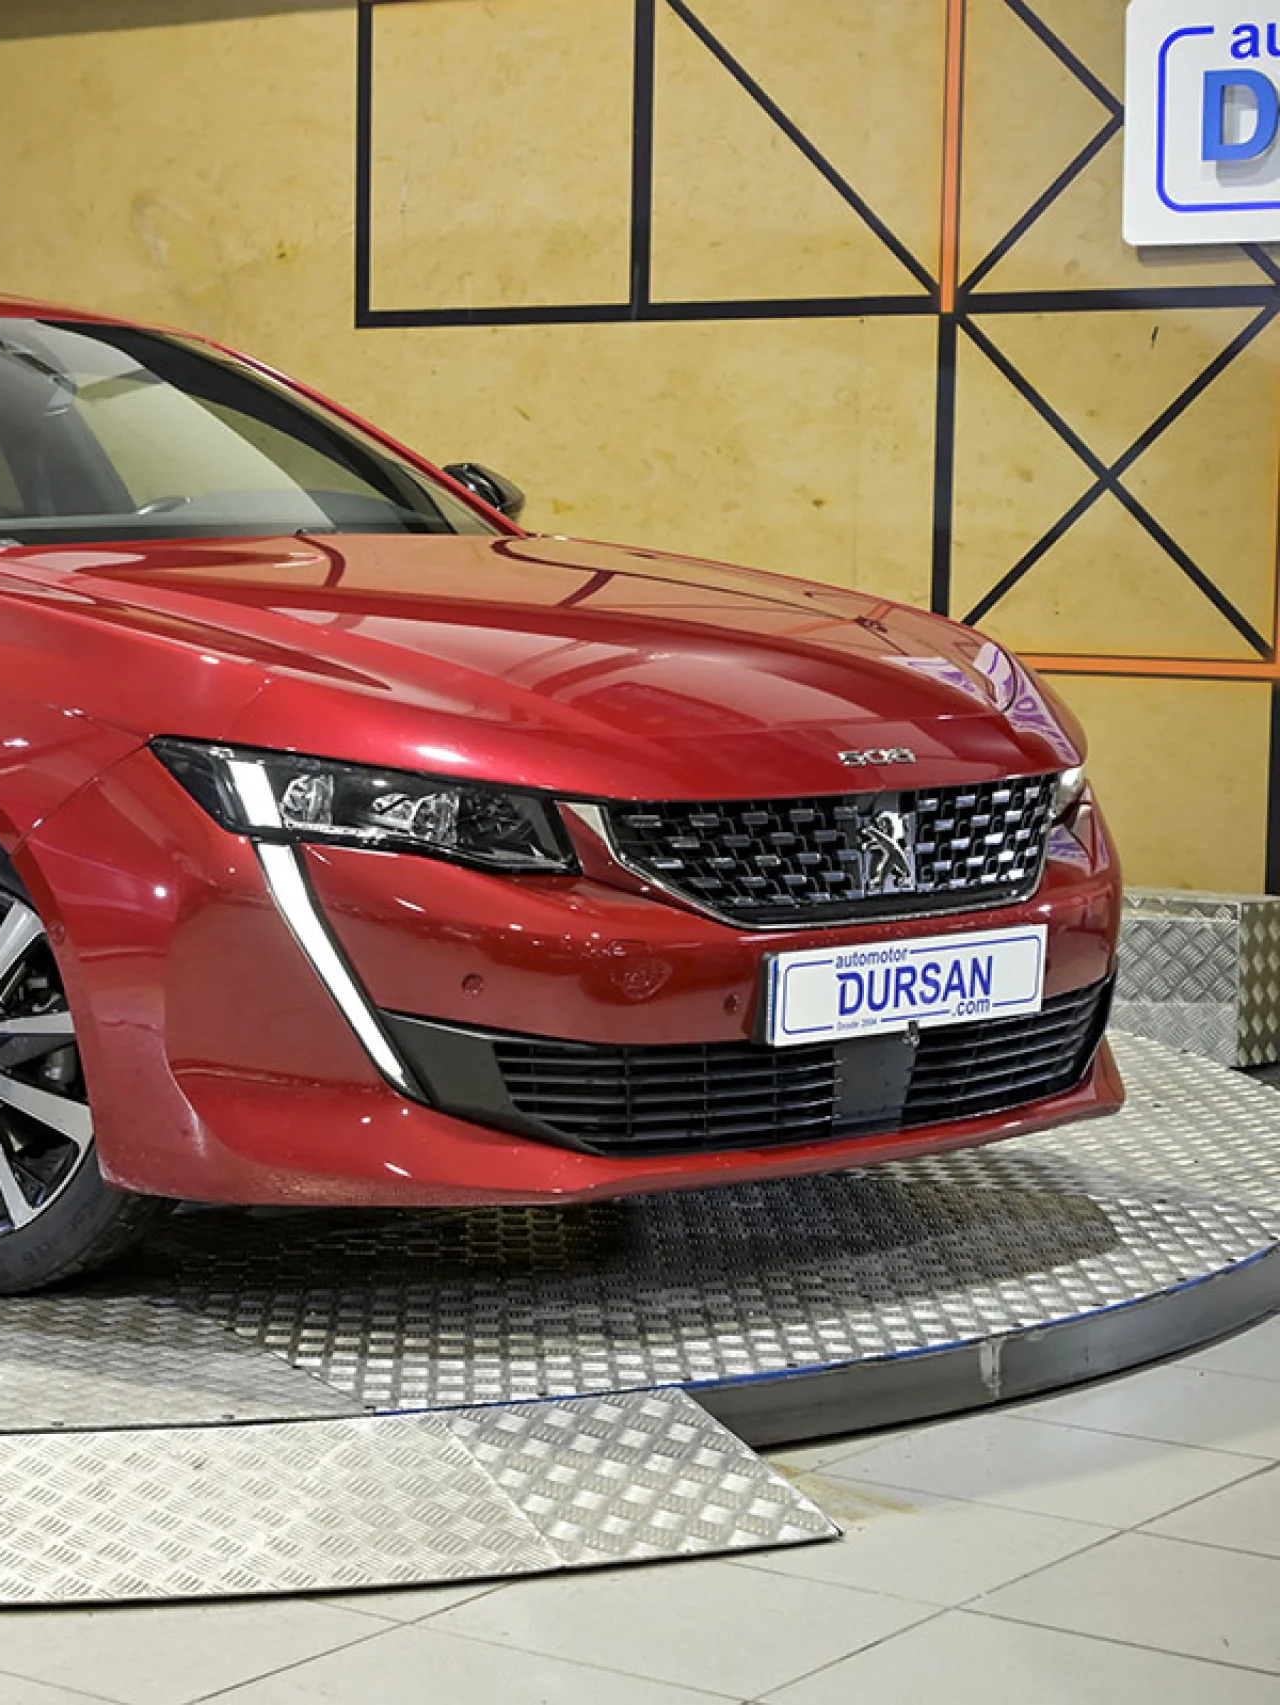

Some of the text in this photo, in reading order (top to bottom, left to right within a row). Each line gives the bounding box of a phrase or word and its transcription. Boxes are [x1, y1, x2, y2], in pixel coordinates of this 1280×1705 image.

[835, 947, 907, 969] automotor
[835, 955, 993, 1016] DURSAN
[951, 998, 991, 1017] .com
